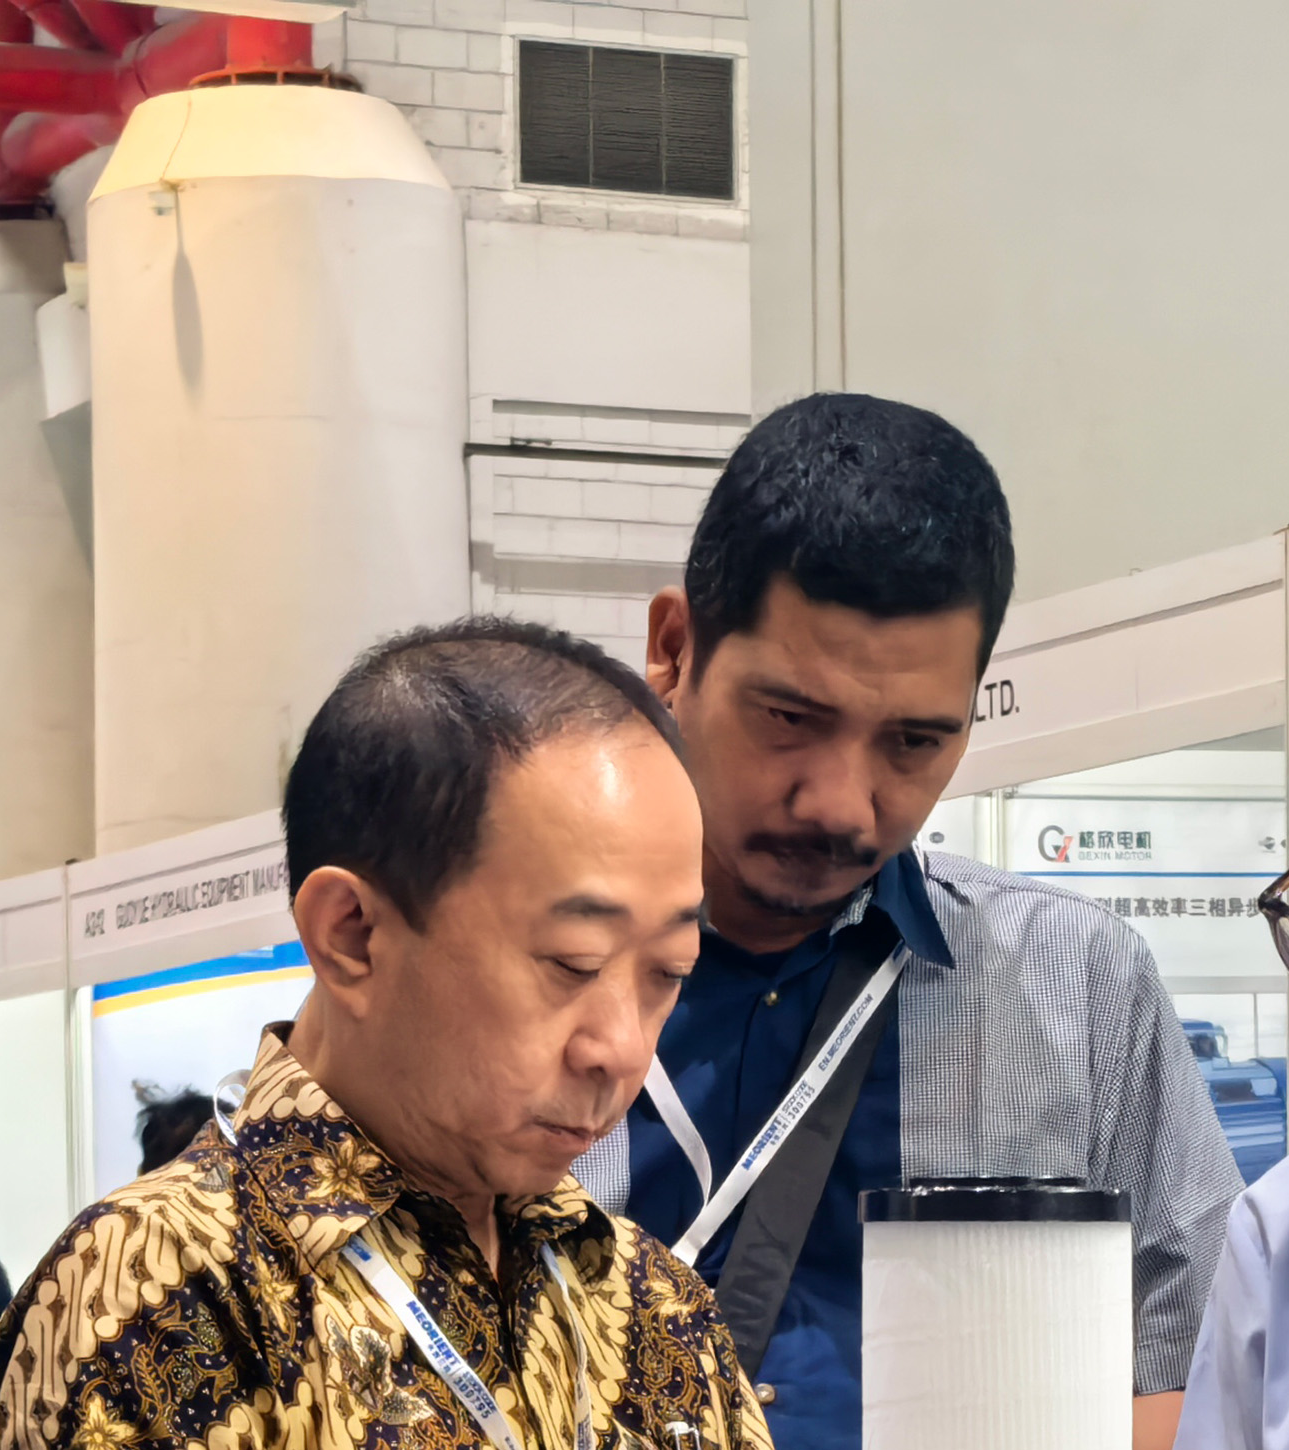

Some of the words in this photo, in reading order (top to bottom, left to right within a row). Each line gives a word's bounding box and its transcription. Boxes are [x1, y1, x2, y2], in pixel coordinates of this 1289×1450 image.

[1114, 851, 1152, 861] MOTOR
[1096, 897, 1260, 918] 超高效率三相异步
[741, 1116, 782, 1171] MEORIENT
[405, 1300, 460, 1367] MEORIENT
